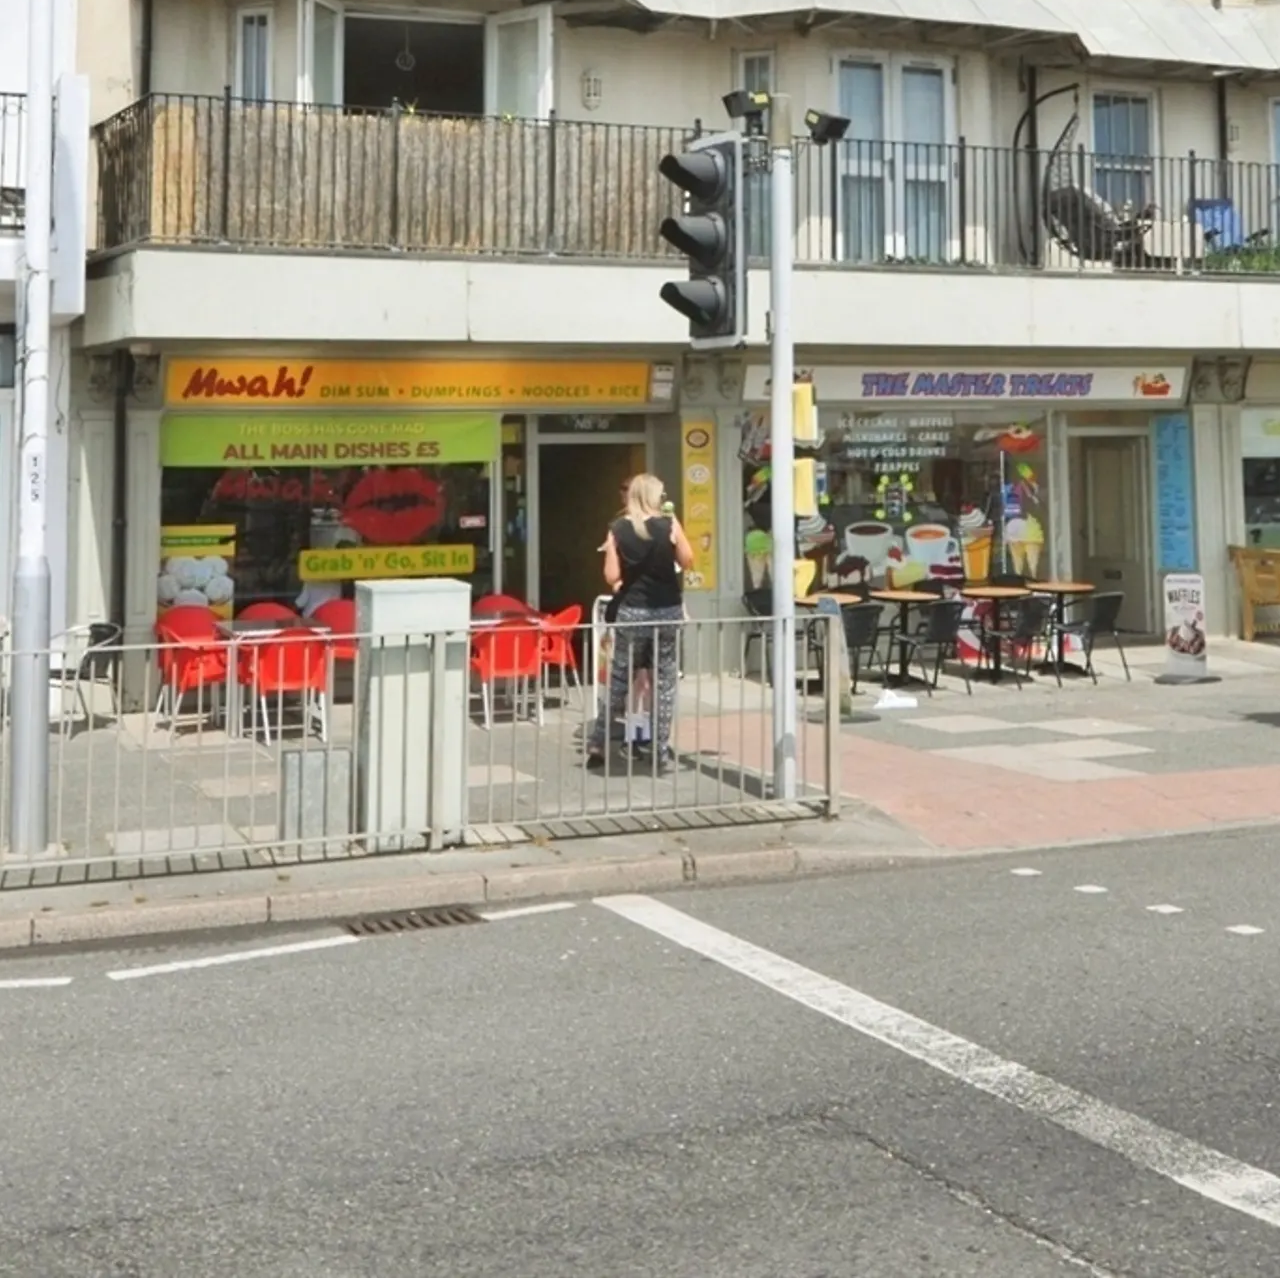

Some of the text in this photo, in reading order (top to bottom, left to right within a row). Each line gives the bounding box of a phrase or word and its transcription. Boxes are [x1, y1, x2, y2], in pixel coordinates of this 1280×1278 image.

[181, 365, 640, 399] Mwah! DIM SUM DUMPLINGS NOODLES RICE
[862, 372, 1094, 397] THE MASTER TREATS
[223, 441, 441, 460] ALL MAIN DISHES £5
[304, 554, 353, 573] Grab
[422, 549, 448, 567] Sit
[451, 548, 470, 566] In
